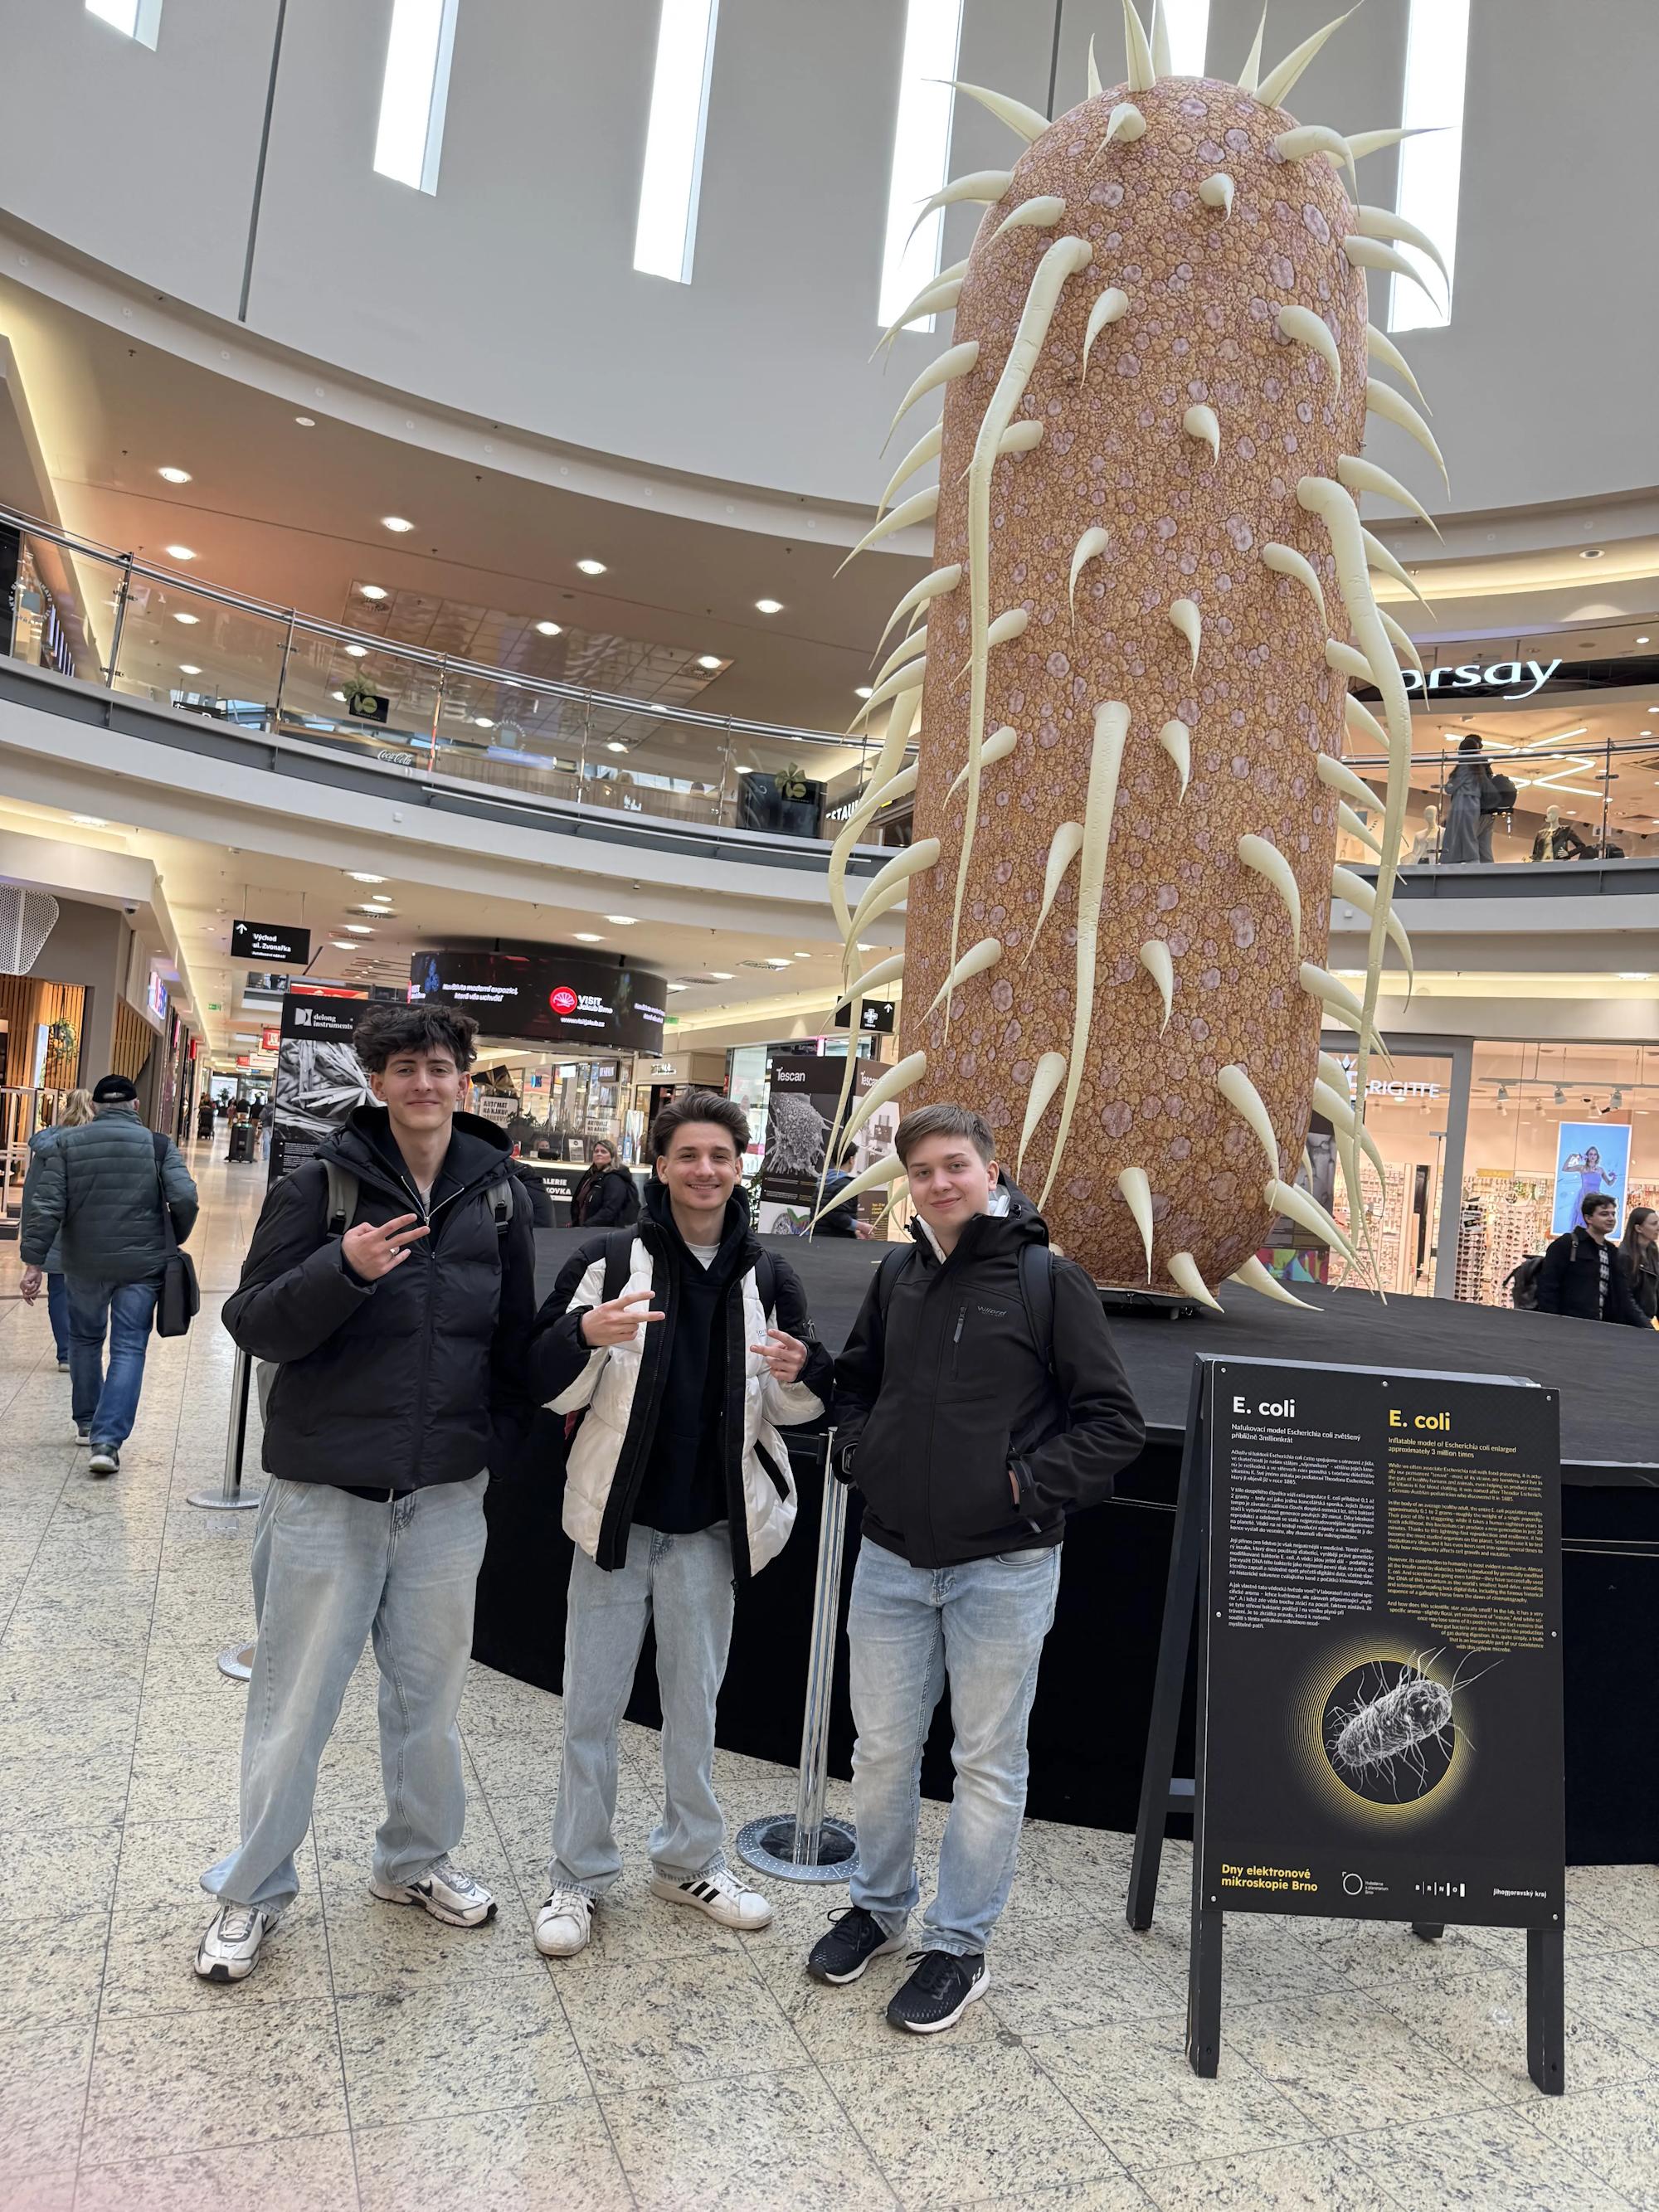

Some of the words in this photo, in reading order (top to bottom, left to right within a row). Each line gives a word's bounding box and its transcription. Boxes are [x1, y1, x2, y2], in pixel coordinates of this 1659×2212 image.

[1401, 659, 1562, 700] orsay
[253, 933, 277, 942] Východ
[262, 943, 291, 952] Zvonařka
[578, 995, 602, 1005] VISIT
[313, 1021, 353, 1029] instruments
[776, 1067, 805, 1082] Tescan
[861, 1070, 878, 1087] Tesca
[1233, 1396, 1252, 1415] E.
[1258, 1399, 1295, 1418] coli
[1389, 1409, 1408, 1427] E.
[1414, 1412, 1451, 1431] coli
[1231, 1424, 1265, 1432] Nafukovací
[1287, 1429, 1321, 1437] Escherichia
[1334, 1432, 1360, 1441] zvětšený
[1231, 1432, 1257, 1441] přibližně
[1388, 1445, 1430, 1455] approximately
[1491, 1445, 1516, 1454] enlarged
[1222, 1864, 1243, 1876] Dny
[1246, 1865, 1311, 1879] elektronové
[1221, 1876, 1288, 1891] mikroskopie
[1292, 1881, 1318, 1892] Brno
[1493, 1888, 1533, 1898] jihomoravský
